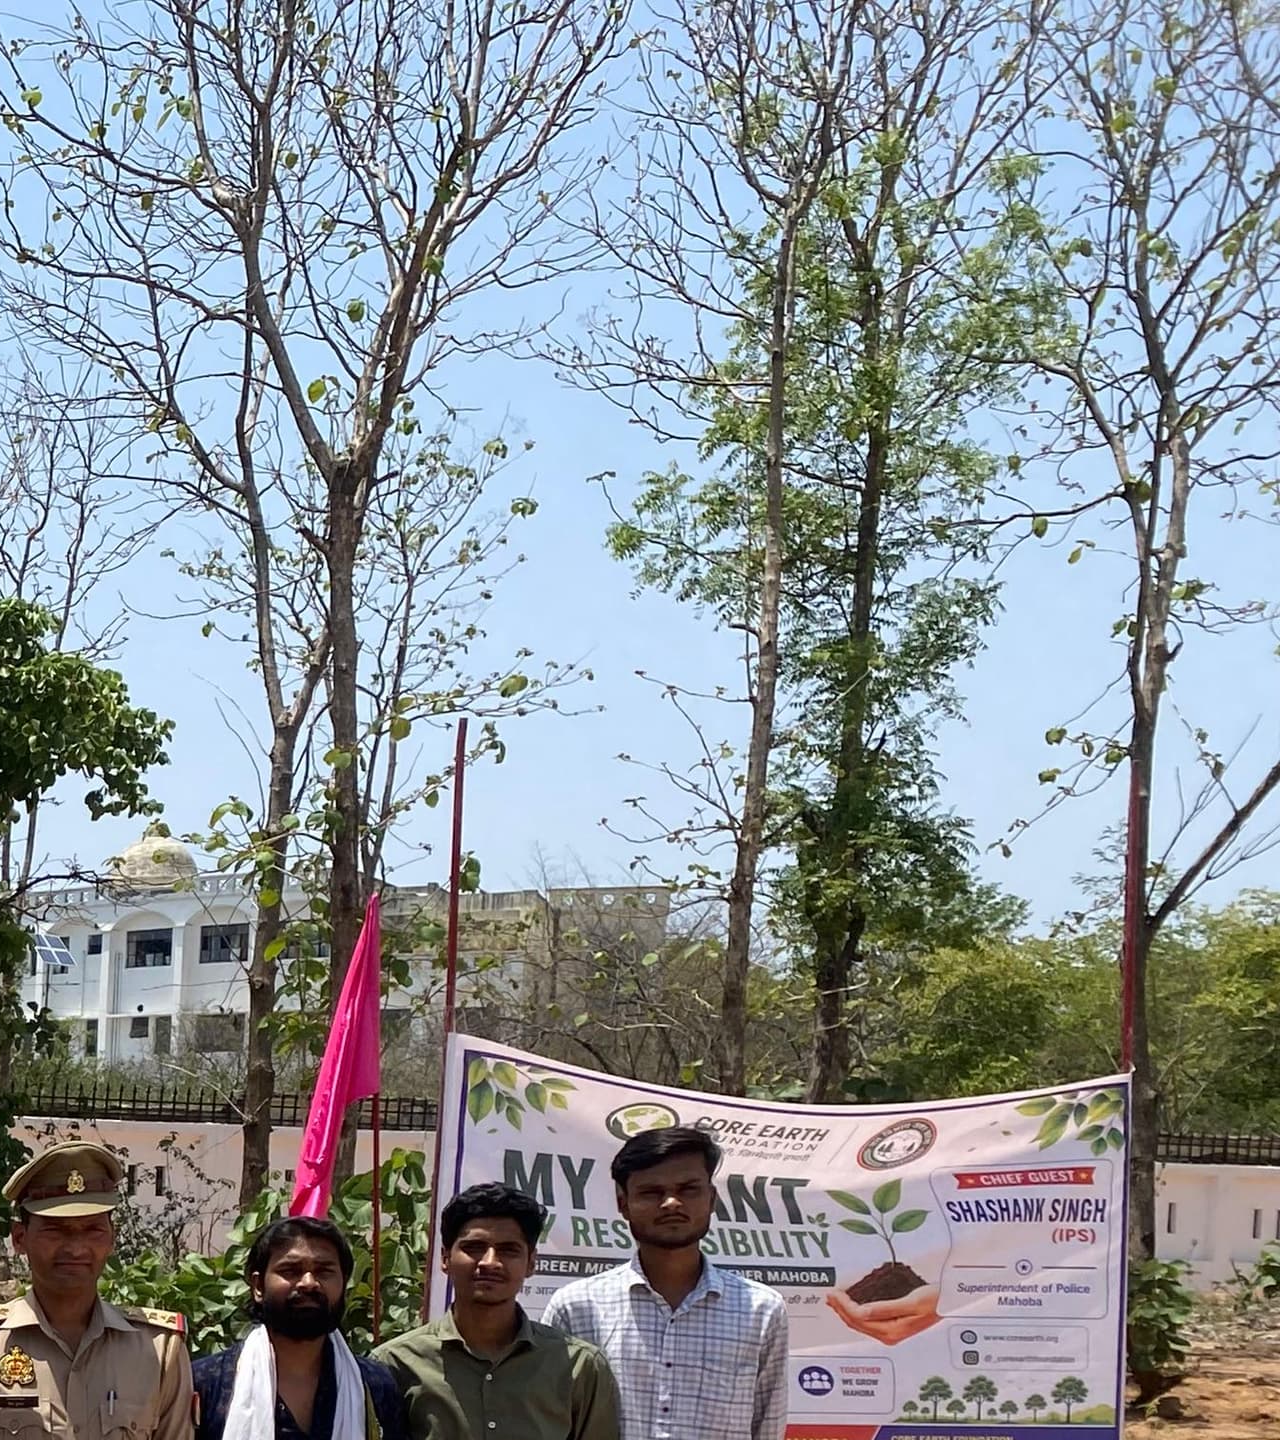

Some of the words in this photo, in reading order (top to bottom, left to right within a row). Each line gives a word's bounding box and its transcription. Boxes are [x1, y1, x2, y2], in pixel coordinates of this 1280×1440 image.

[695, 1116, 757, 1137] CORE
[756, 1124, 831, 1143] EARTH
[504, 1148, 596, 1211] MY
[980, 1173, 1025, 1186] CHIEF
[1028, 1169, 1076, 1183] GUEST
[946, 1198, 1047, 1223] SHASHANK
[1048, 1198, 1107, 1223] SINGH
[1051, 1228, 1097, 1245] (IPS)
[767, 1270, 830, 1283] MAHOBA
[957, 1282, 1038, 1296] Superintendent
[1041, 1283, 1053, 1294] of
[1056, 1283, 1091, 1294] Police
[997, 1296, 1043, 1307] Mahoba
[840, 1366, 881, 1374] TOGETHER
